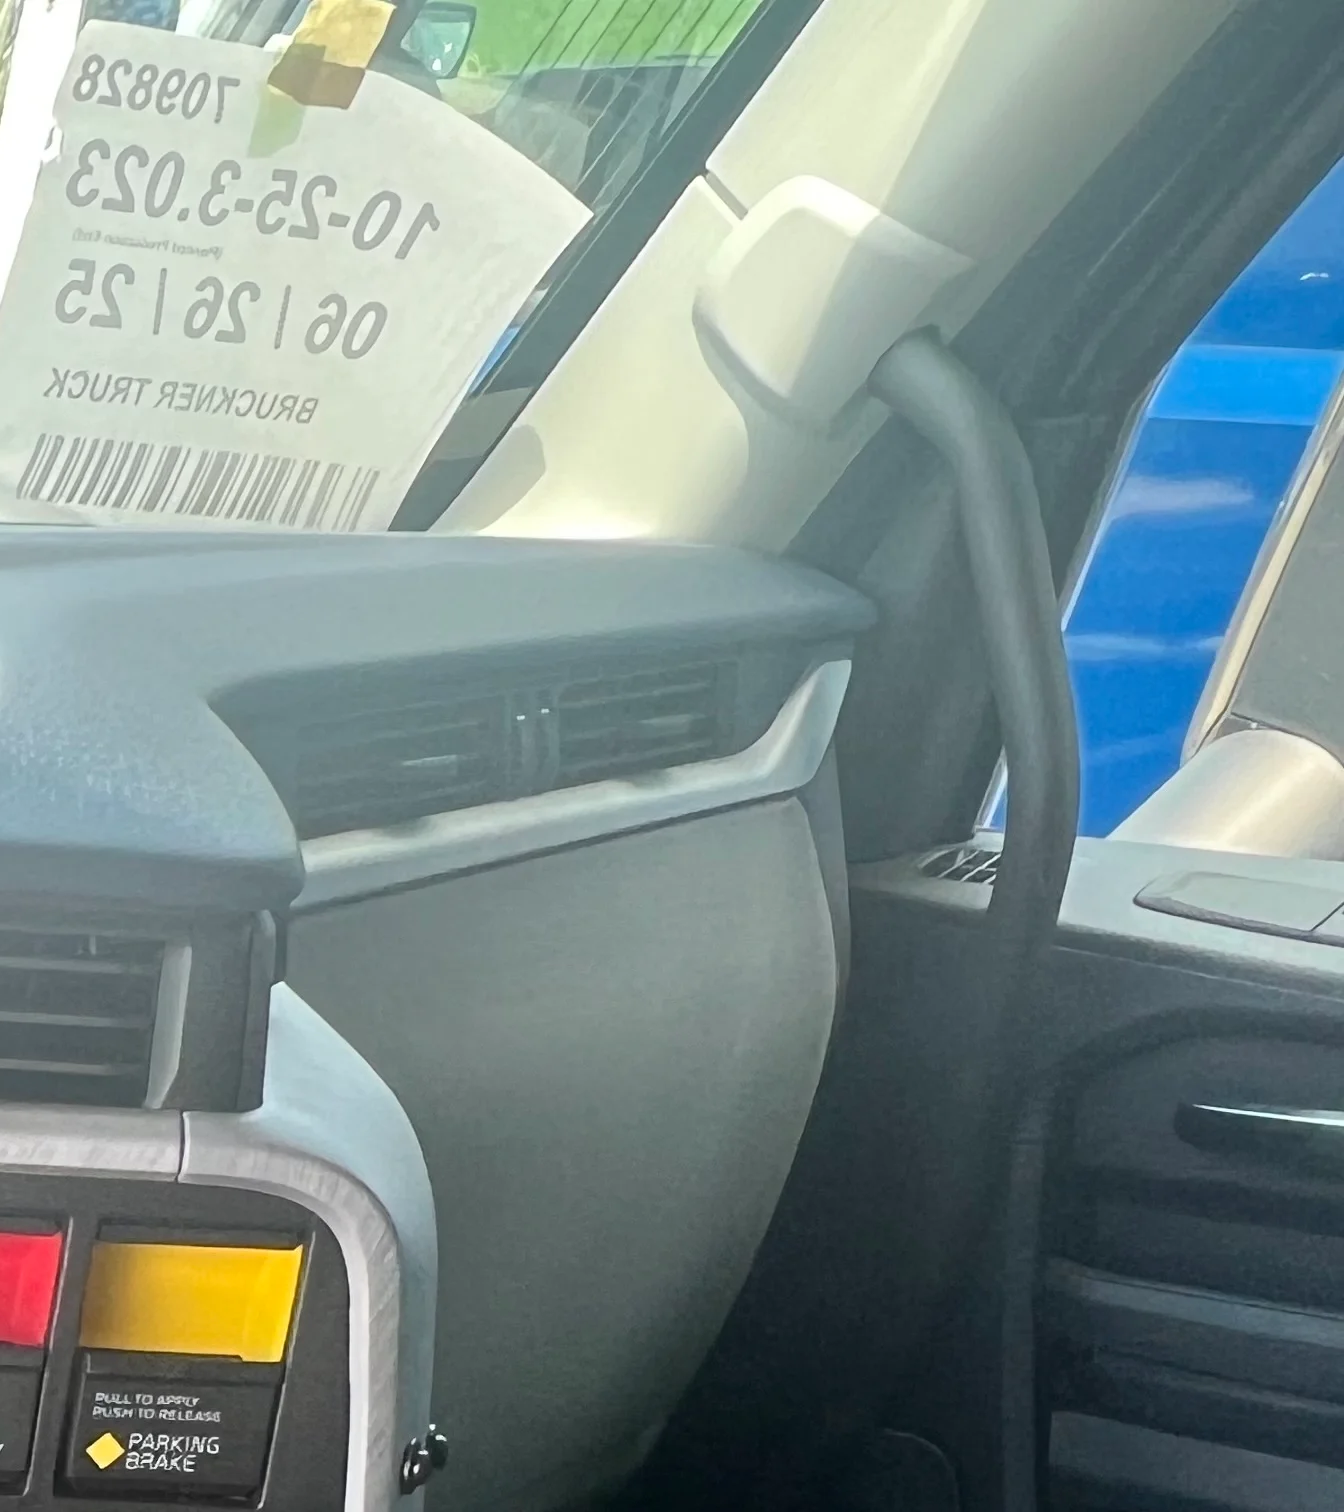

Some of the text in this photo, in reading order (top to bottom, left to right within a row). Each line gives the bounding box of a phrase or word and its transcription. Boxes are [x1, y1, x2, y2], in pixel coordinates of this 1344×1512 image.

[95, 1392, 200, 1407] PULL TO APPLY
[92, 1406, 221, 1422] PUSH TO RELEASE
[128, 1432, 220, 1454] PARKING
[125, 1452, 197, 1473] BRAKE
